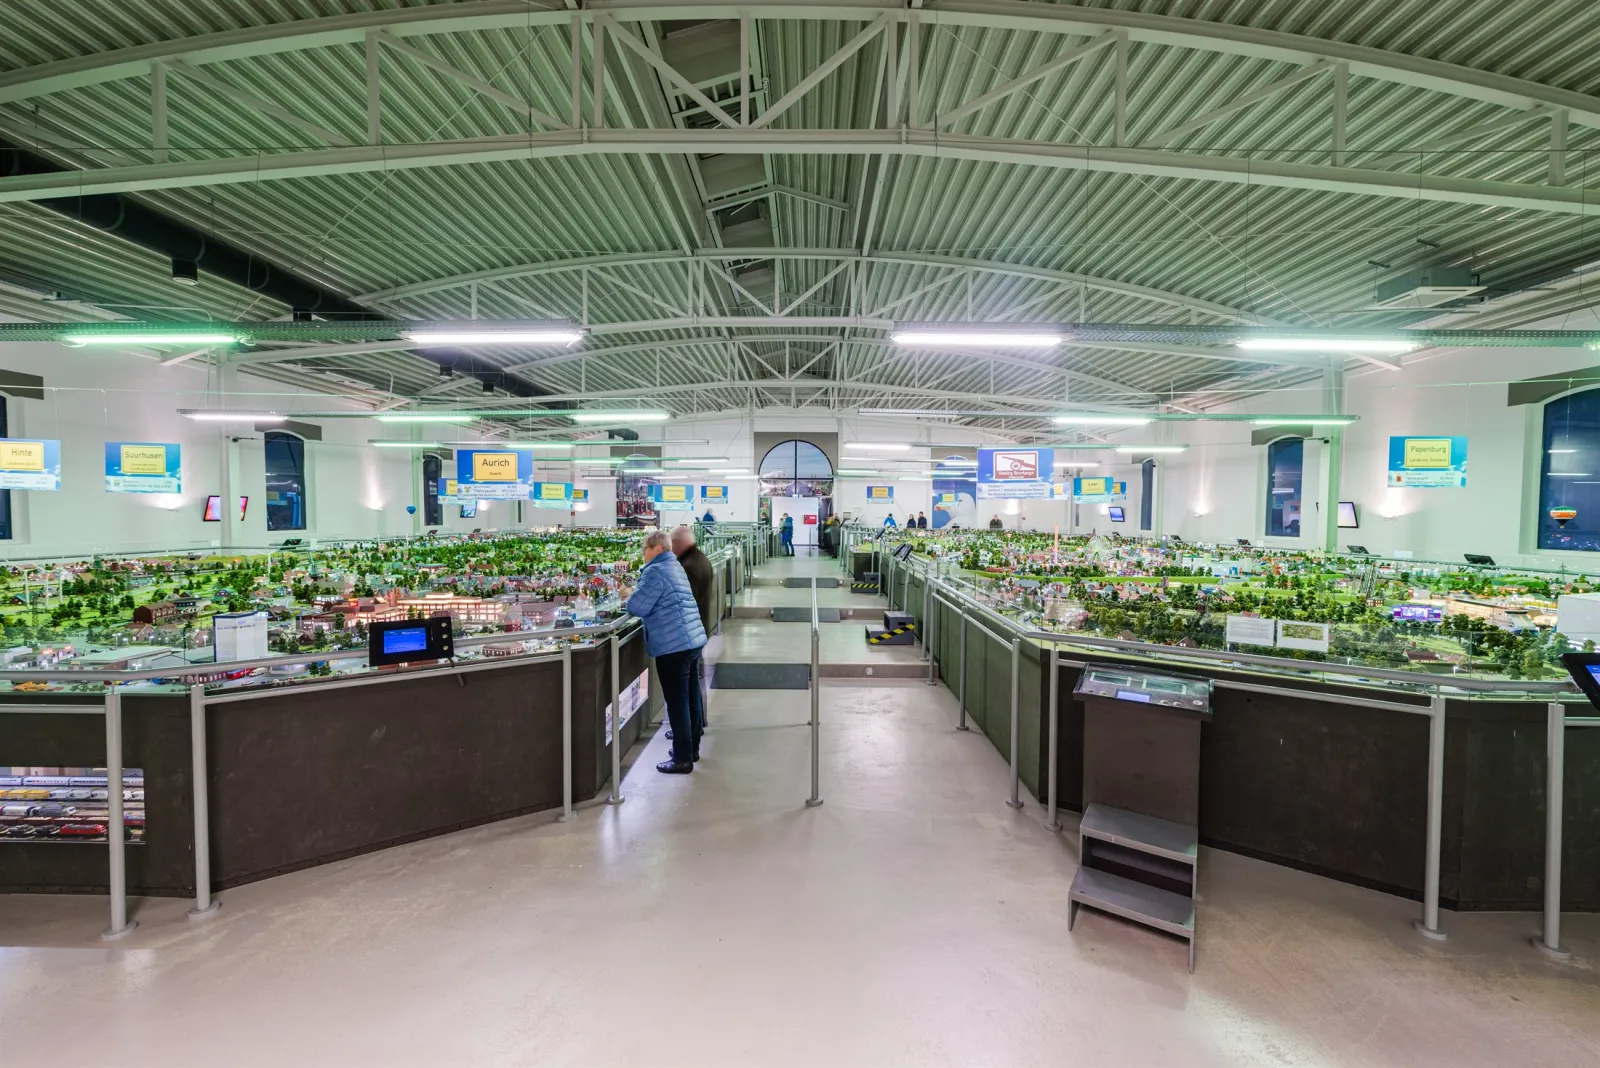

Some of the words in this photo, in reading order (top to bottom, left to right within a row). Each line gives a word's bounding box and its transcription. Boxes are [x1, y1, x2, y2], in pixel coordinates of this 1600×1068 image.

[11, 448, 33, 457] Hinte
[1410, 446, 1447, 454] Papenburg
[124, 451, 163, 459] Suurhusen
[481, 458, 510, 467] Aurich
